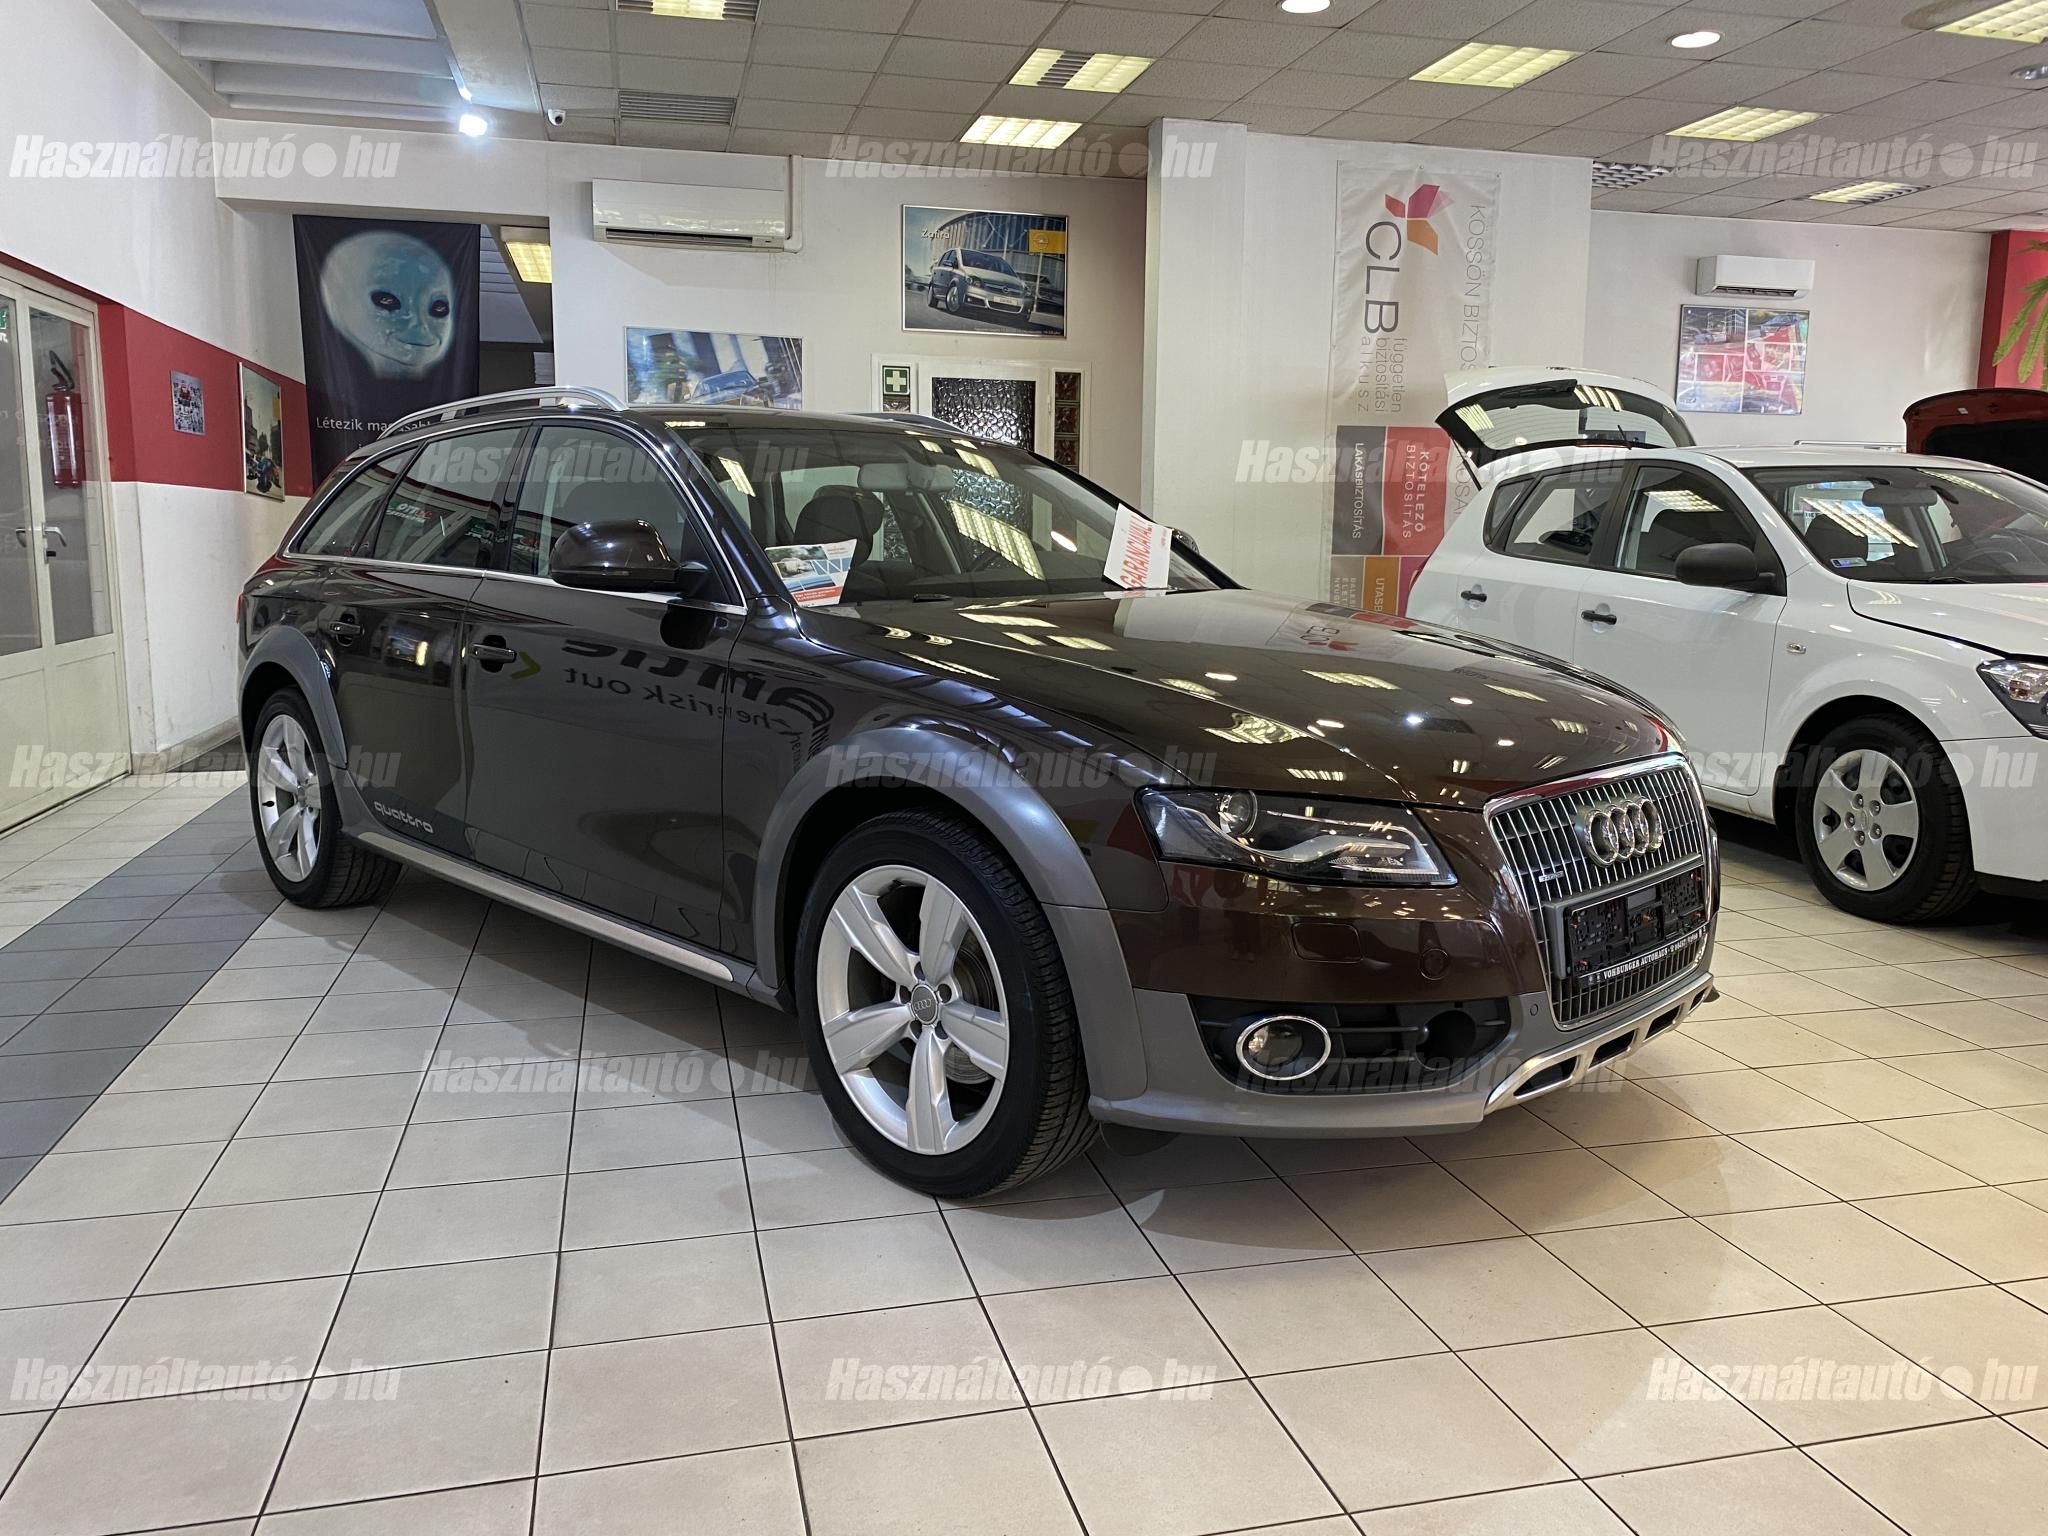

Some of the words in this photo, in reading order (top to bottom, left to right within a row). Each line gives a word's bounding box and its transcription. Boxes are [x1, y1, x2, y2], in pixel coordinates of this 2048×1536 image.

[1364, 221, 1401, 334] CLB
[1389, 337, 1408, 413] független
[316, 417, 363, 430] Létezik
[1402, 444, 1416, 539] BIZTOSÍTÁS
[374, 801, 434, 833] quattro
